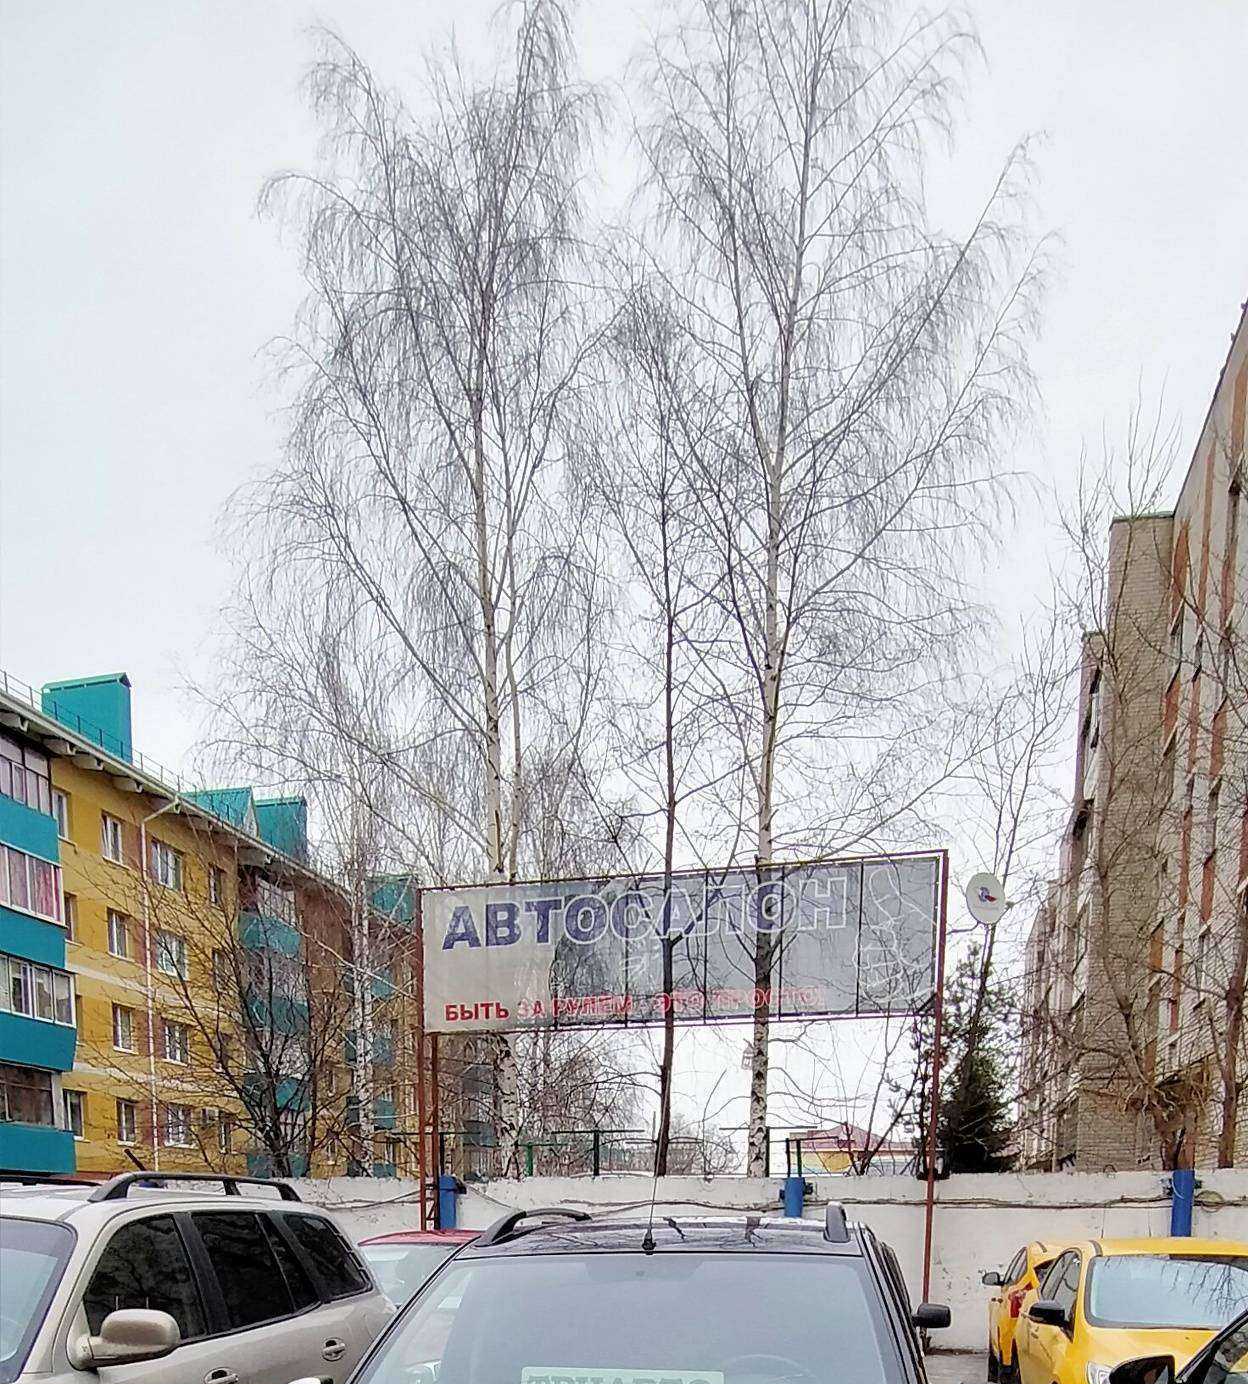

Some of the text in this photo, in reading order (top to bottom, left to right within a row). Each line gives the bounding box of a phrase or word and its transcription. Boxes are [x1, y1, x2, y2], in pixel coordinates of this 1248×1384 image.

[441, 875, 848, 951] АВТОСАЛОН
[444, 1001, 510, 1022] БЫТЬ
[517, 999, 546, 1020] ЗА
